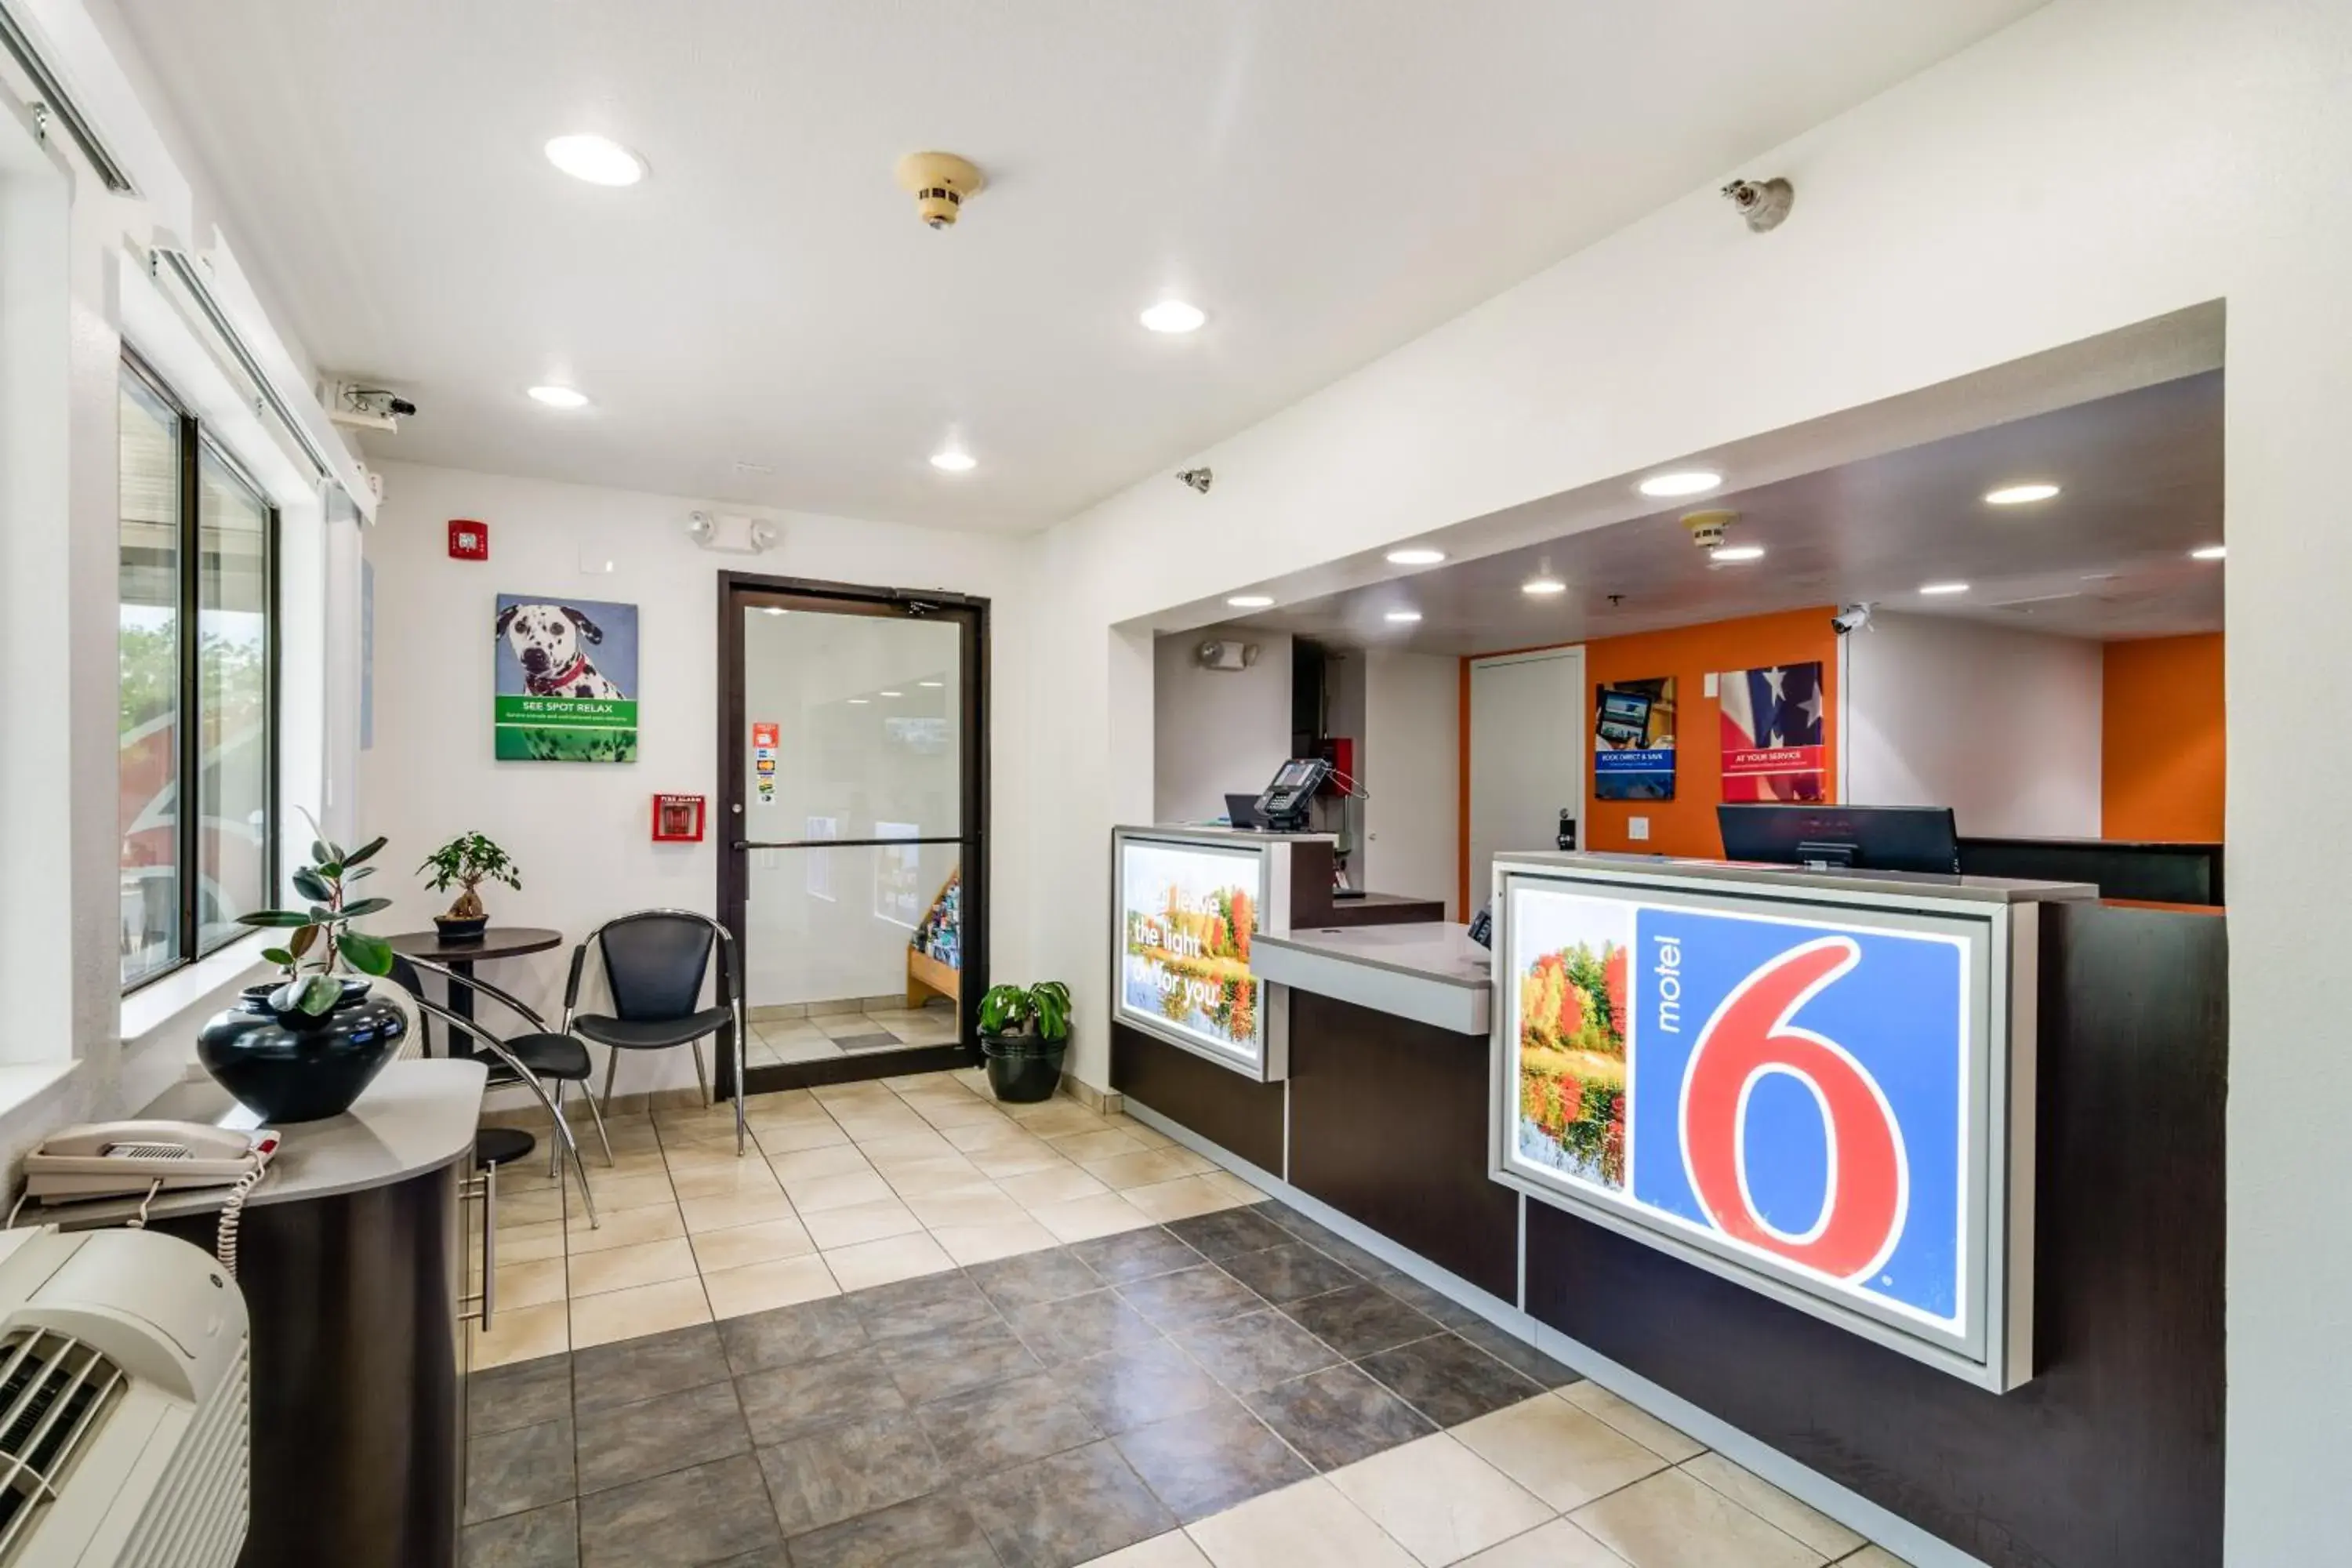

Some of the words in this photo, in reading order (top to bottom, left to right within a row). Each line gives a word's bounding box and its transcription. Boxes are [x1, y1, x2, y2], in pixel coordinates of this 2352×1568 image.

[523, 701, 544, 711] SEE
[546, 702, 573, 712] SPOT
[576, 703, 612, 713] RELAX
[1769, 751, 1801, 760] SERVICE
[1135, 915, 1159, 946] the
[1163, 918, 1202, 961] light
[1653, 935, 1681, 1034] motel
[1678, 935, 1910, 1287] 6
